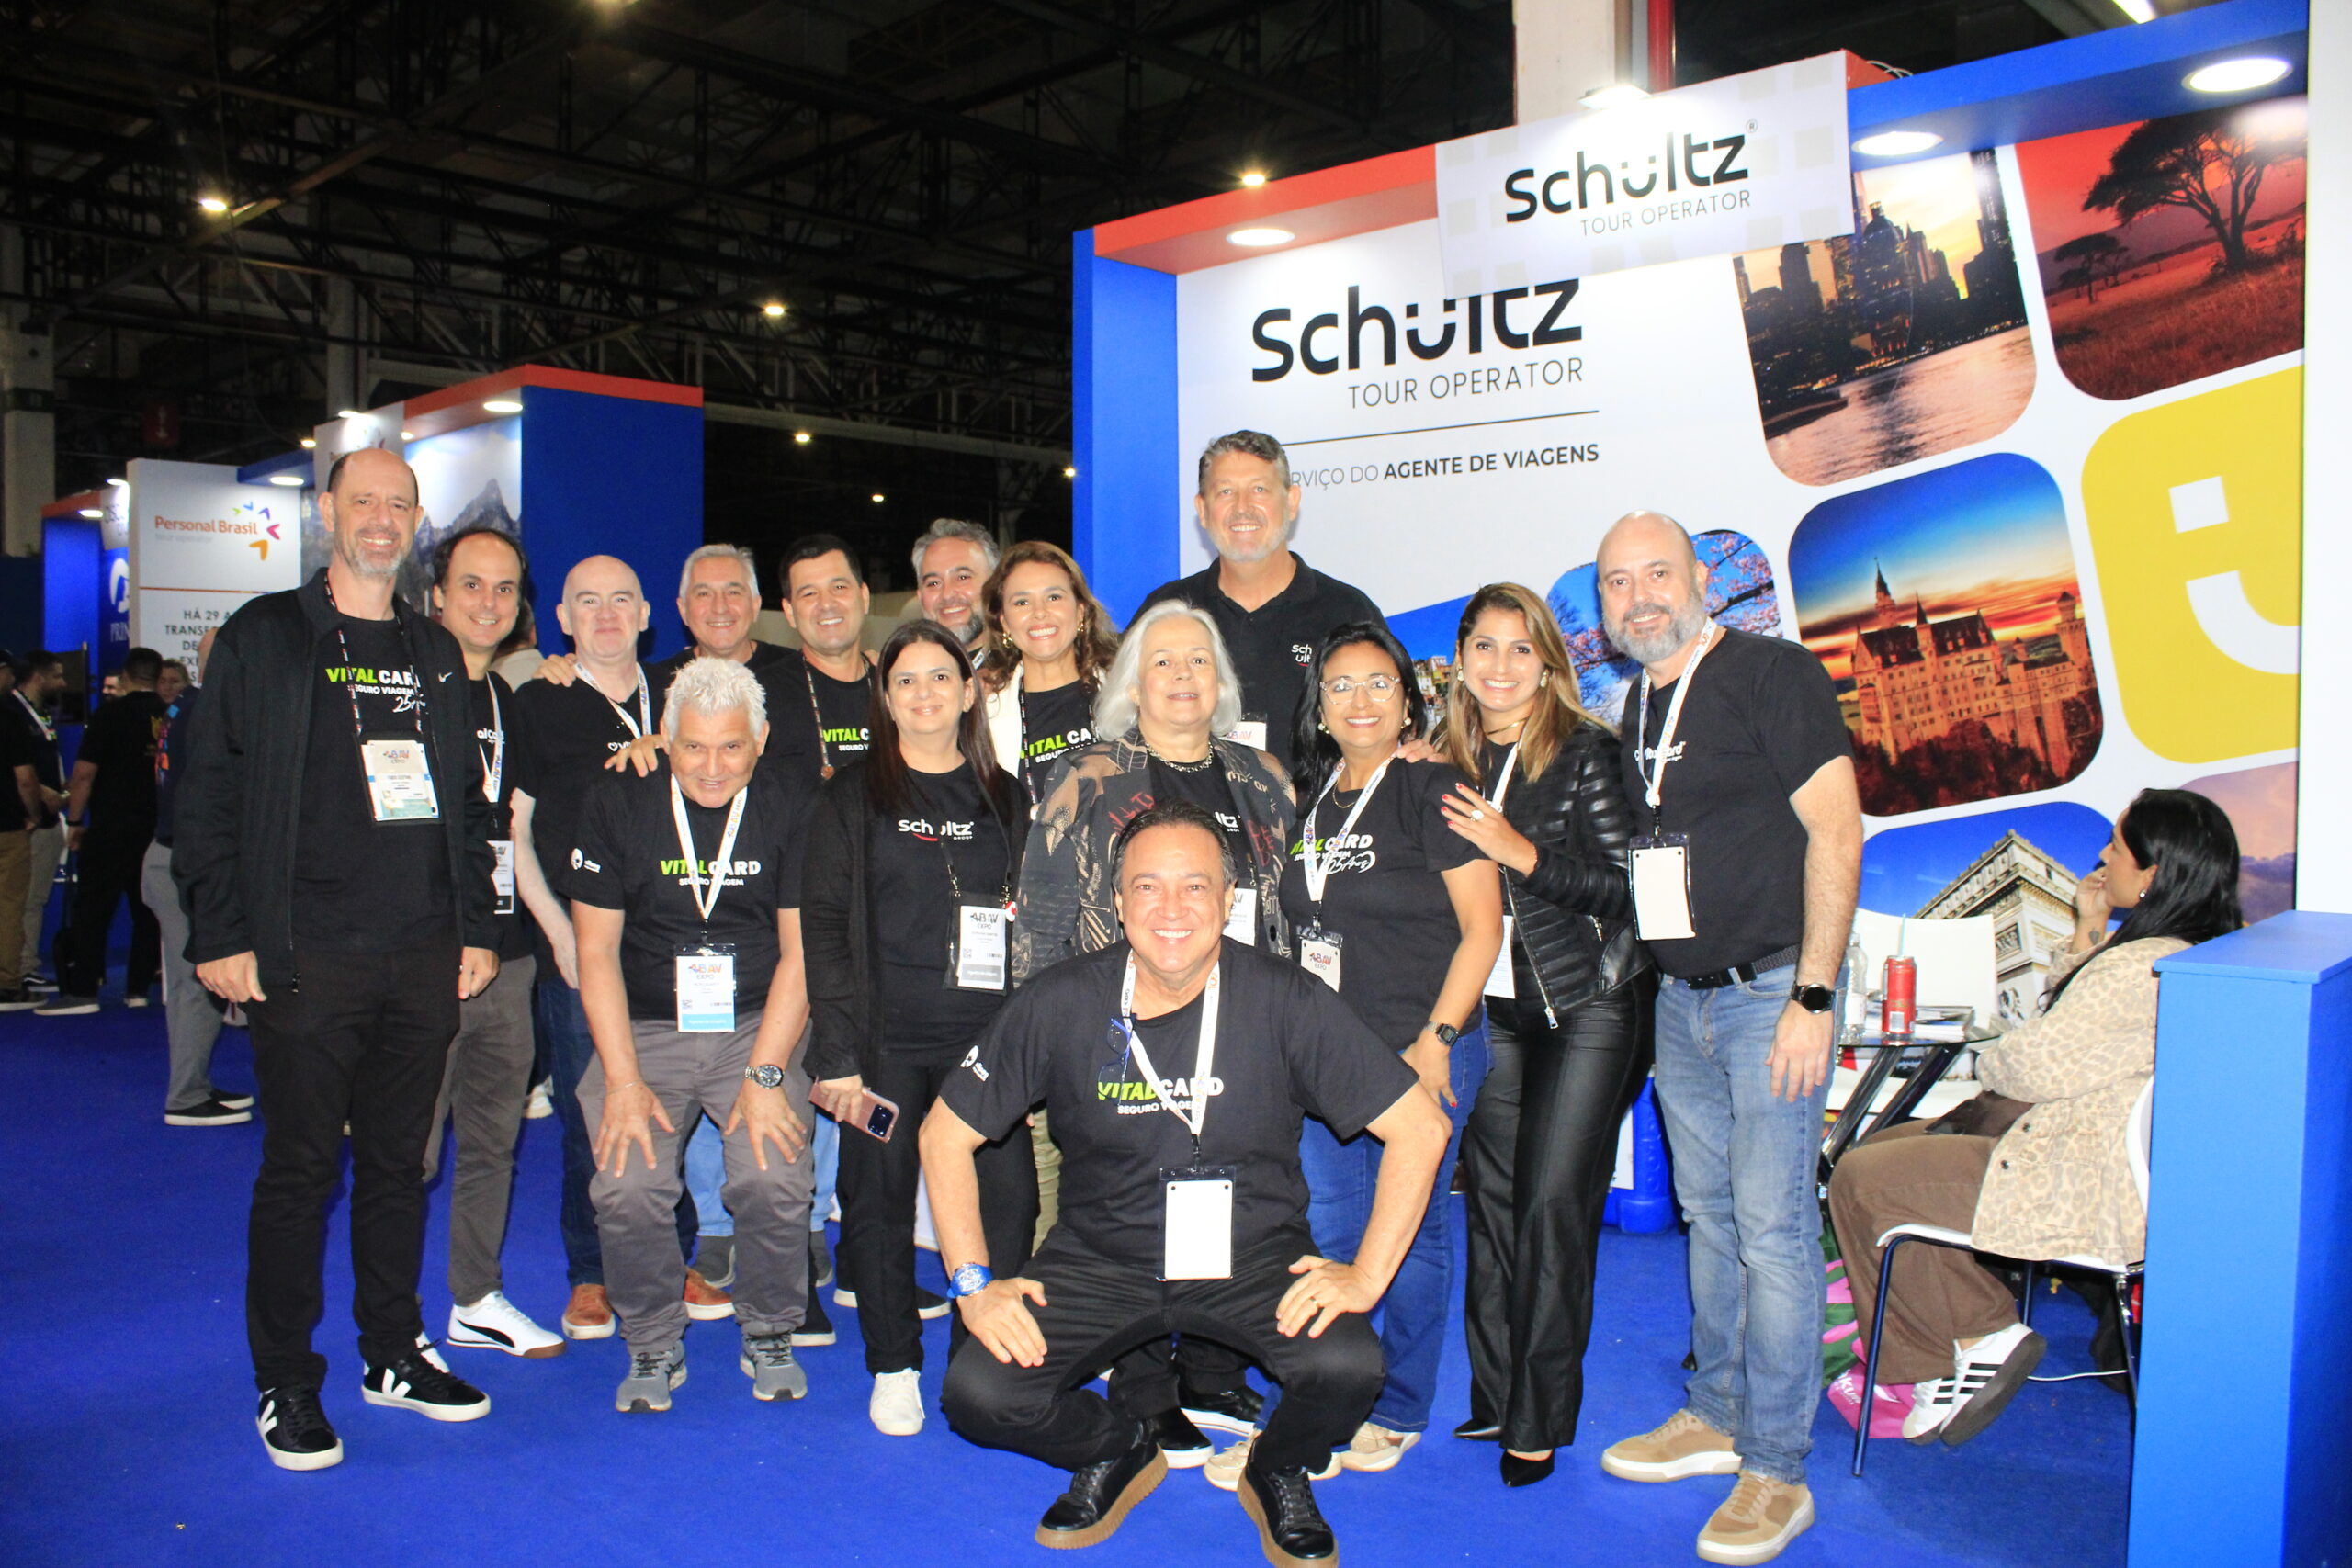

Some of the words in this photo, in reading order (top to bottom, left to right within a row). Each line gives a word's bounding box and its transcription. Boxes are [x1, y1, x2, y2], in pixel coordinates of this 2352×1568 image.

[1580, 212, 1633, 236] TOUR
[1641, 189, 1750, 225] OPERATOR
[1348, 378, 1418, 409] TOUR
[1430, 357, 1583, 399] OPERATOR
[1291, 468, 1345, 491] RVIÇO
[1351, 465, 1379, 484] DO
[1384, 457, 1463, 480] AGENTE
[1470, 453, 1498, 472] DE
[1503, 444, 1600, 469] VIAGENS
[154, 515, 216, 533] Personal
[219, 520, 258, 535] Brasil
[184, 607, 200, 620] HÁ
[206, 611, 220, 620] 29
[381, 687, 415, 695] VIAGEM
[822, 728, 869, 742] VITALC
[1117, 1103, 1159, 1114] SEGURO
